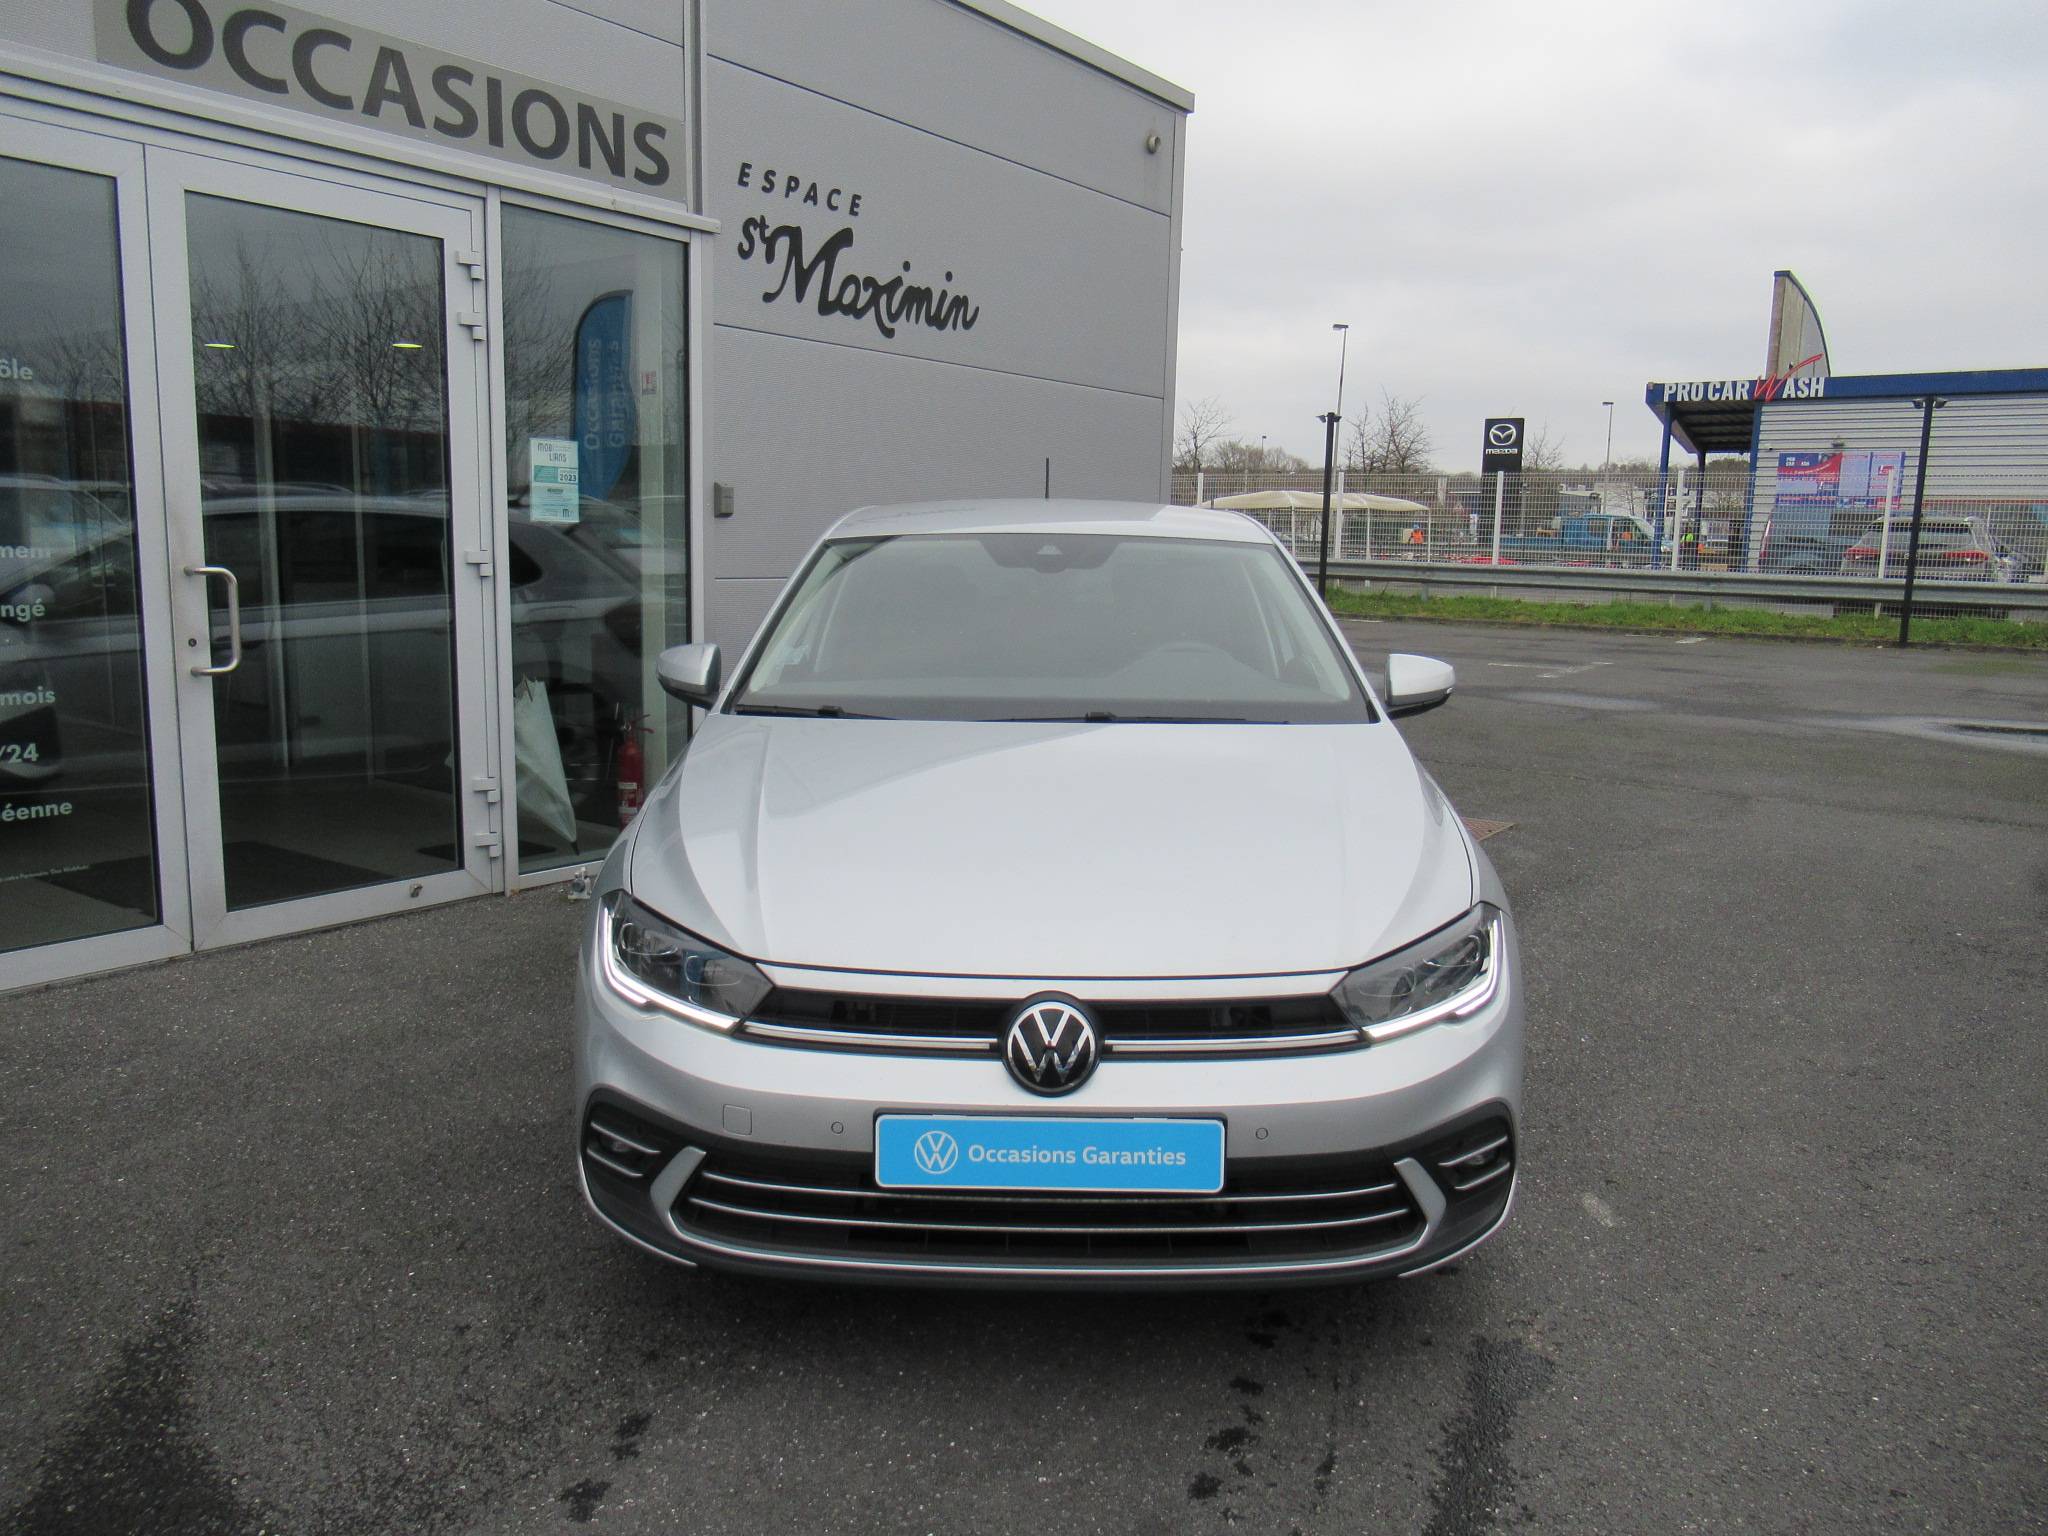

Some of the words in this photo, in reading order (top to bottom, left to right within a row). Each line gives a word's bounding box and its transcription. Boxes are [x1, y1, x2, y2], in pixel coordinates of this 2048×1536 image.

[126, 0, 671, 187] OCCASIONS
[738, 163, 862, 216] ESPACE
[762, 227, 980, 339] Maximin
[1664, 382, 1705, 402] PRO
[1708, 380, 1749, 401] CAR
[559, 473, 577, 482] 2023
[968, 1144, 1076, 1165] Occasions
[1082, 1146, 1187, 1166] Garanties
